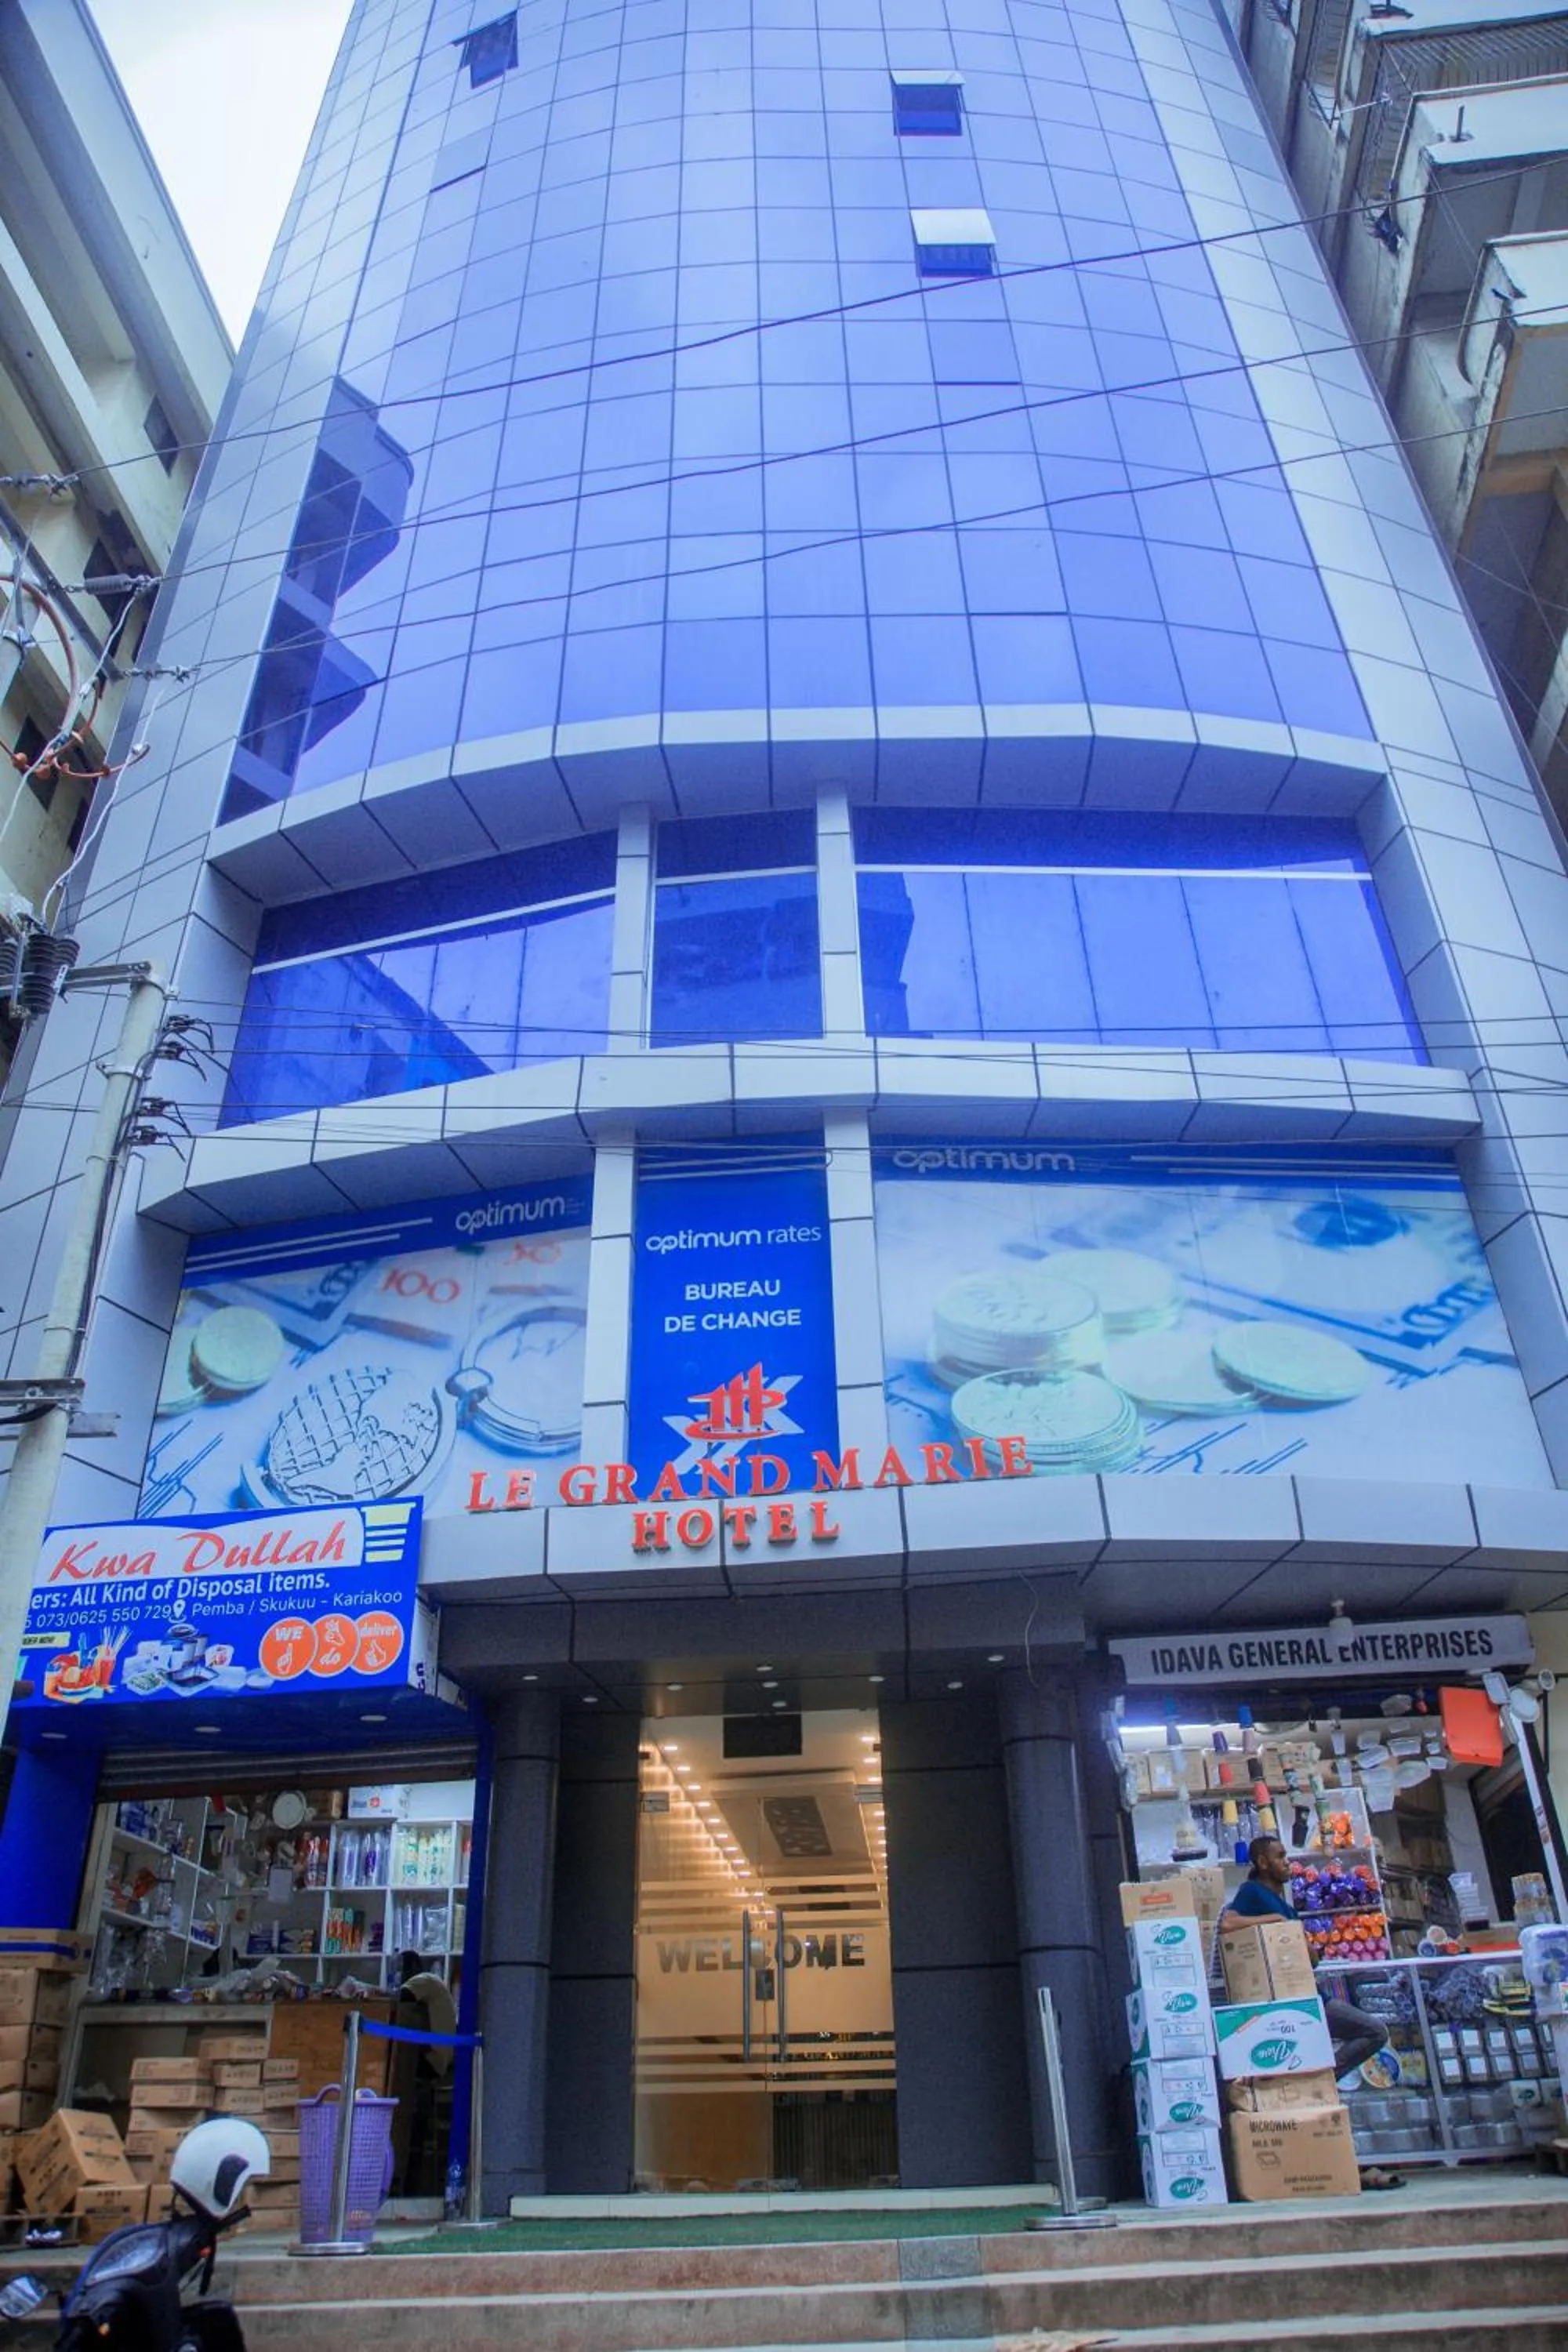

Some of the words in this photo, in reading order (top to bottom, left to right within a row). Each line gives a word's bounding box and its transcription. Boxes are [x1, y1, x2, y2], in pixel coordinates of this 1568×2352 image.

[892, 1146, 1076, 1174] optimum
[456, 1195, 565, 1235] optimum
[645, 1229, 762, 1254] optimum
[767, 1225, 822, 1244] rates
[684, 1279, 782, 1301] BUREAU
[664, 1314, 697, 1334] DE
[701, 1308, 802, 1331] CHANGE
[464, 1468, 537, 1513] LE
[558, 1454, 791, 1506] GRAND
[811, 1436, 1034, 1493] MARIE
[632, 1501, 841, 1552] HOTEL
[48, 1540, 158, 1583] Kwa
[176, 1519, 347, 1574] Dullah
[70, 1585, 97, 1607] All
[102, 1581, 147, 1604] Kind
[151, 1579, 176, 1600] of
[176, 1572, 263, 1601] Disposal
[268, 1572, 331, 1593] items.
[192, 1601, 245, 1617] Pemba
[259, 1595, 317, 1613] Skukuu
[332, 1590, 403, 1607] Kariakoo
[36, 1610, 107, 1628] 073/0625
[111, 1606, 140, 1622] 550
[143, 1605, 172, 1620] 729
[275, 1626, 304, 1641] WE
[319, 1647, 342, 1666] do
[1150, 1645, 1224, 1675] IDAVA
[1229, 1637, 1333, 1670] GENERAL
[1338, 1628, 1494, 1663] ENTERPRISES
